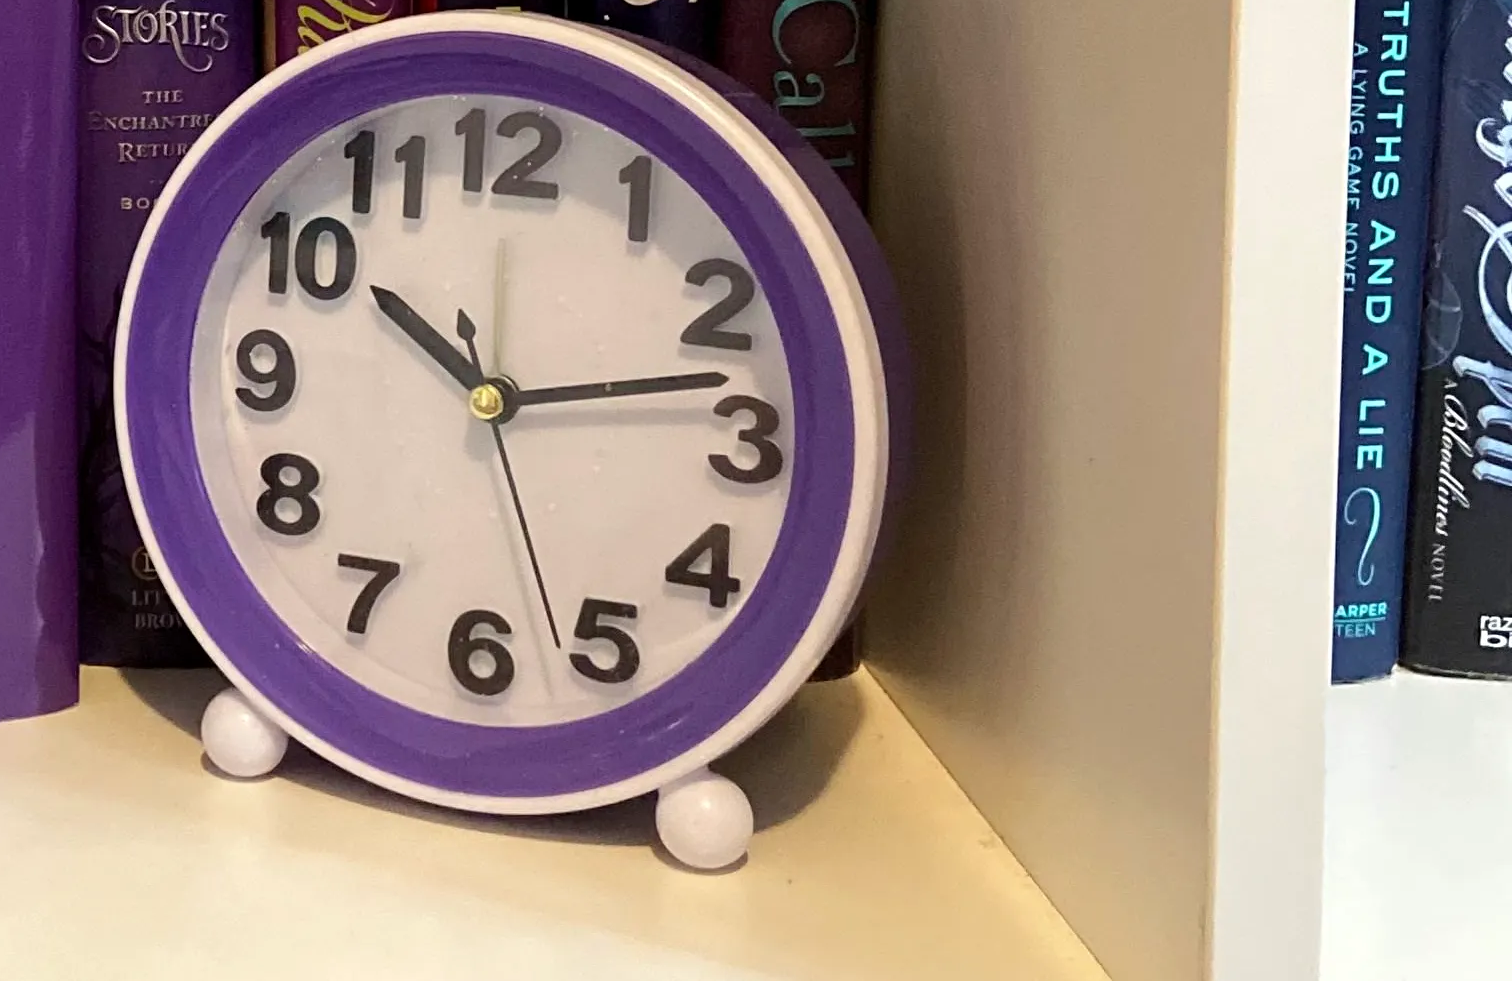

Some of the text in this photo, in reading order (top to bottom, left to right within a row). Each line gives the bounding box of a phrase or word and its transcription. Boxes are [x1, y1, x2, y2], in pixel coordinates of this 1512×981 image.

[82, 0, 229, 73] STORIES
[1353, 42, 1369, 58] A
[142, 90, 184, 104] THE
[1349, 69, 1368, 135] LYING
[1372, 0, 1412, 200] TRUTHS
[118, 142, 191, 163] RETUR
[343, 130, 426, 220] 11
[453, 107, 564, 200] 12
[121, 197, 158, 210] BO
[618, 155, 654, 243] 1
[261, 211, 357, 301] 10
[1364, 220, 1397, 325] AND
[680, 257, 755, 352] 2
[235, 329, 296, 412] 9
[1362, 343, 1389, 377] A
[707, 394, 784, 485] 3
[1355, 399, 1386, 471] LIE
[256, 453, 321, 537] 8
[336, 553, 401, 636] 7
[665, 522, 741, 609] 4
[1427, 543, 1446, 601] NOVEL
[447, 609, 516, 696] 6
[568, 598, 641, 684] 5
[1335, 622, 1376, 638] TEEN
